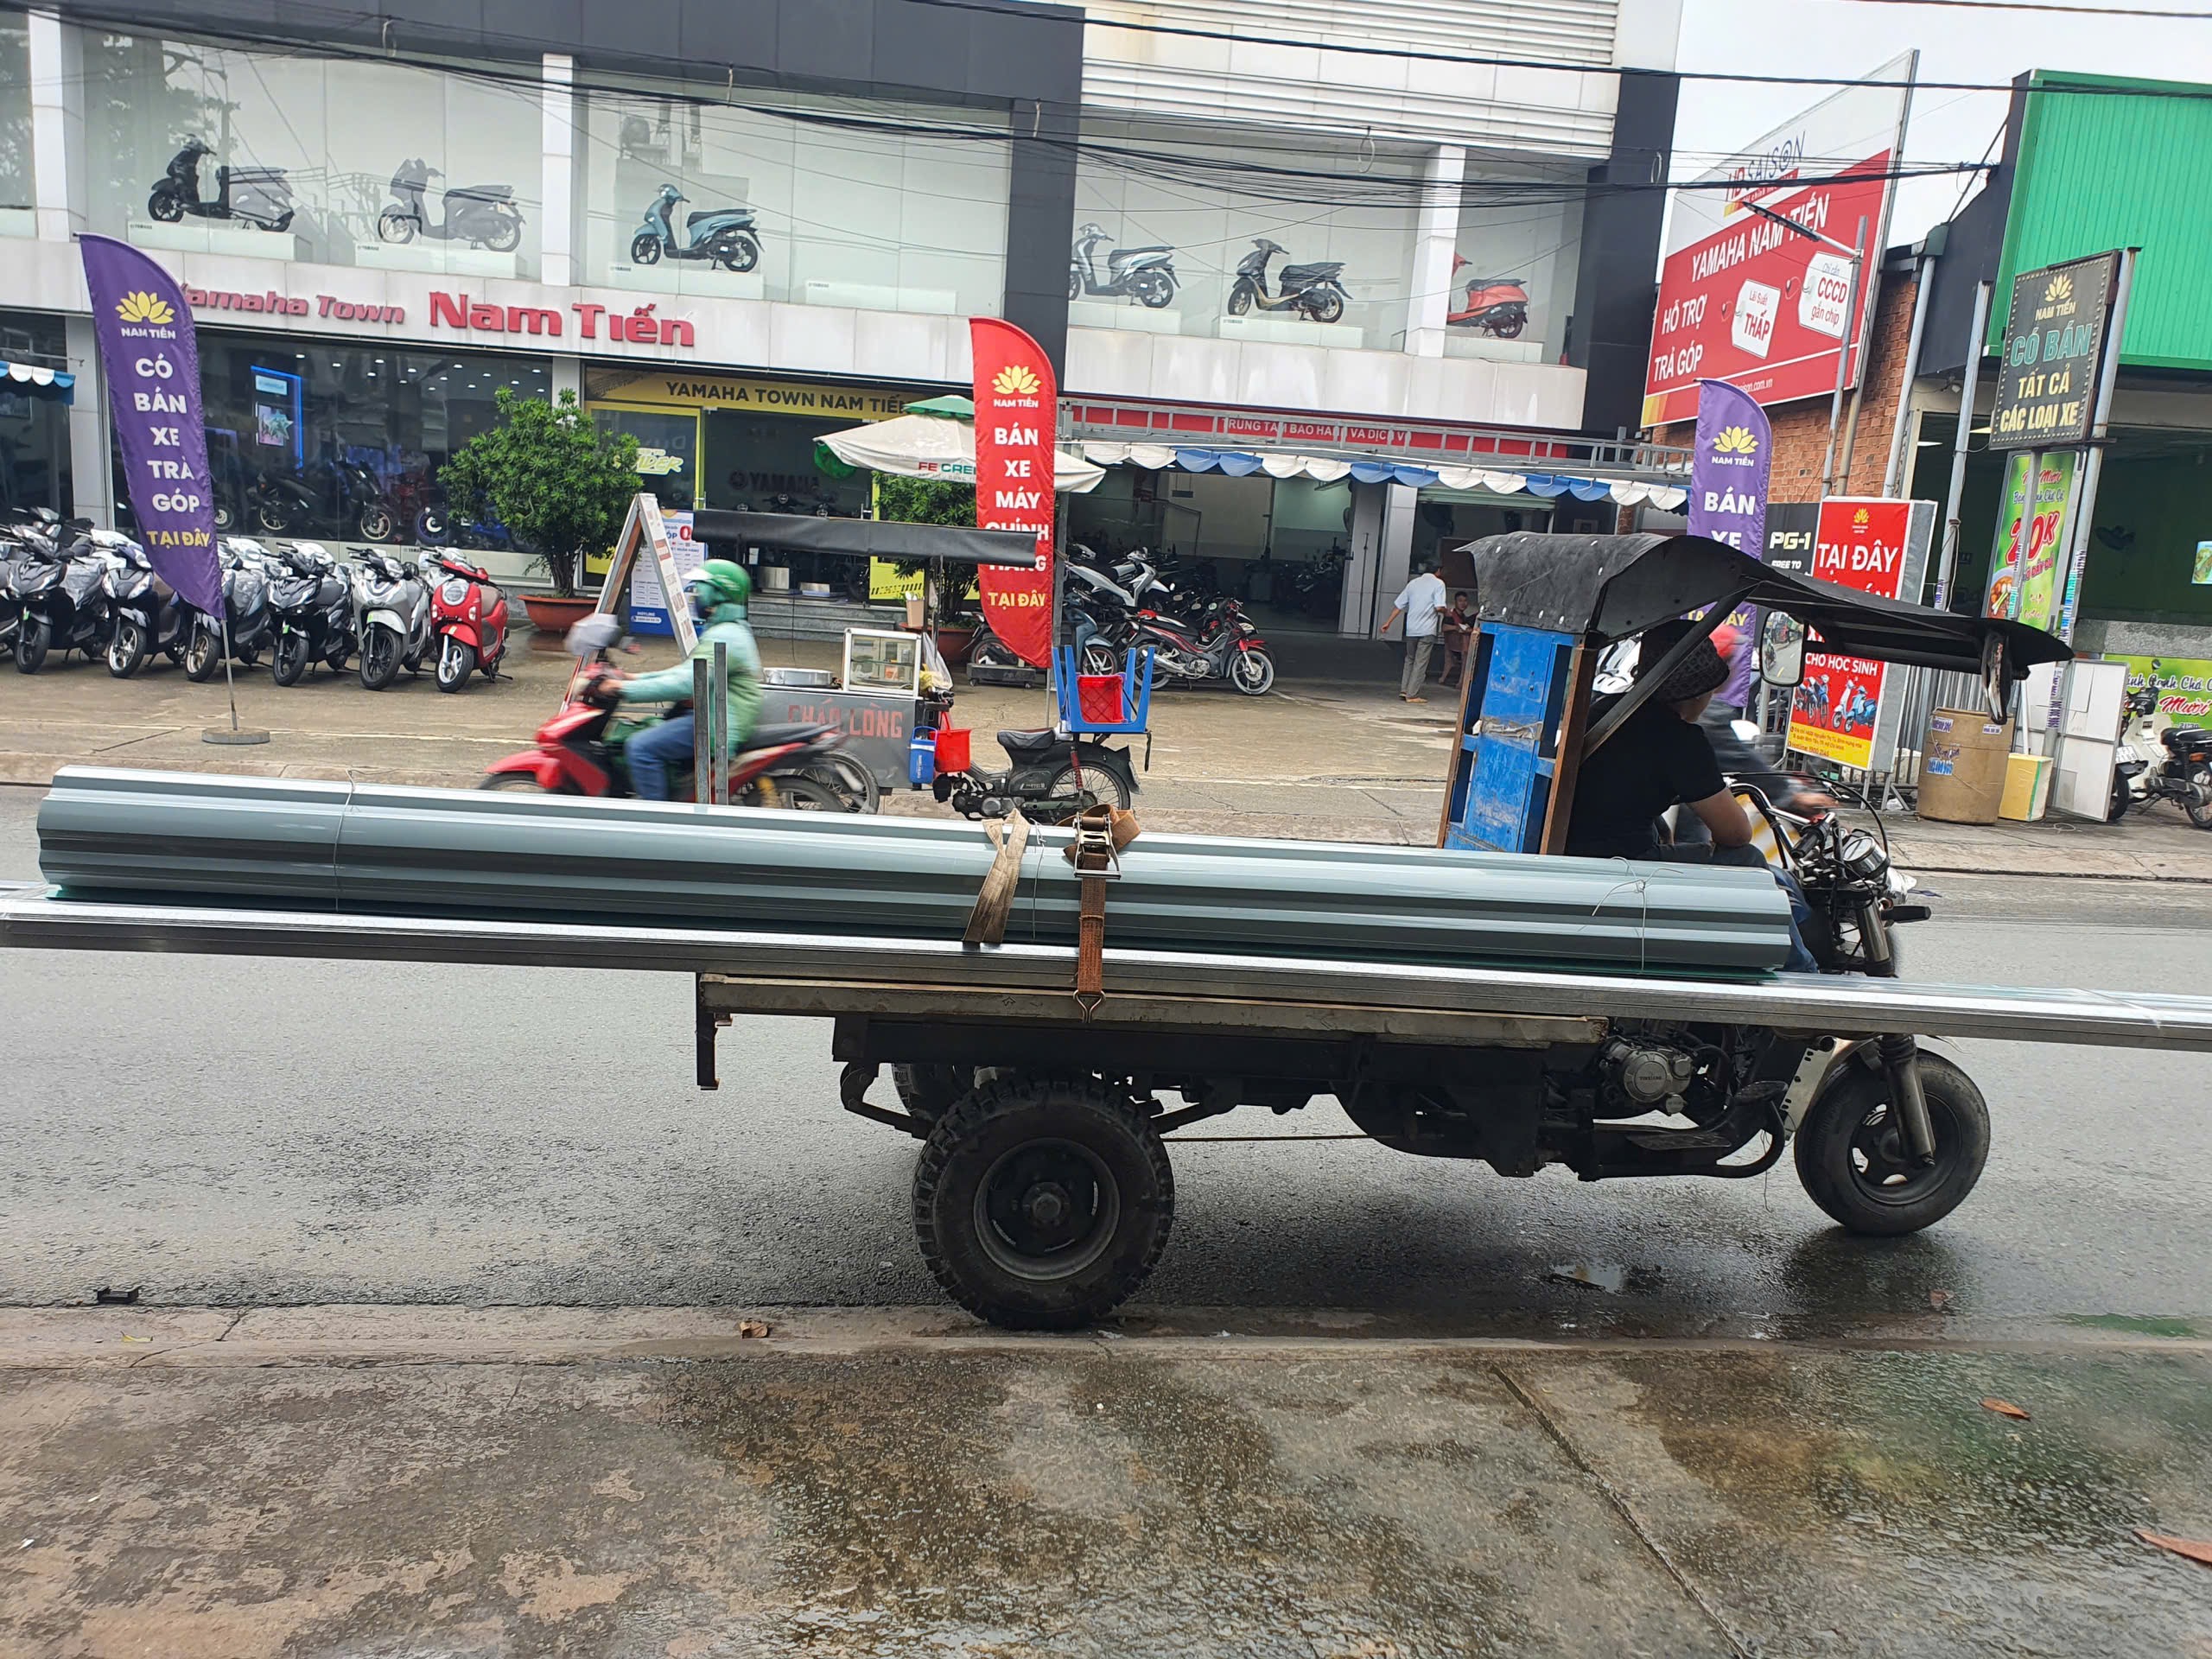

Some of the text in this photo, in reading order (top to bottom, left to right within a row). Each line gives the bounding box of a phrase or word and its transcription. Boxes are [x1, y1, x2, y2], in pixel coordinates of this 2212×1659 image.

[1692, 191, 1830, 283] YAMAHA NAM TIẾN
[1817, 276, 1848, 304] CCCD
[181, 283, 405, 324] amaha Town
[1662, 293, 1708, 335] HỖ TRỢ
[2035, 305, 2055, 321] NAM
[429, 291, 696, 347] Nam Tiến
[1744, 309, 1770, 341] THẤP
[1824, 307, 1840, 327] chip
[121, 327, 149, 339] NAM
[2010, 320, 2093, 367] CÓ BÁN
[135, 353, 174, 379] CÓ
[1654, 340, 1704, 382] TRẢ GÓP
[2018, 362, 2071, 400] TẤT CẢ
[133, 385, 188, 414] BÁN
[665, 381, 750, 402] YAMAHA
[754, 388, 816, 408] TOWN
[820, 394, 864, 411] NAM
[993, 398, 1016, 408] NAM
[1999, 400, 2081, 434] CÁC LOẠI XE
[149, 427, 181, 447] XE
[995, 422, 1039, 446] BÁN
[1368, 429, 1394, 442] DỊC
[918, 461, 976, 475] FE CRE
[1004, 459, 1031, 478] XE
[1711, 455, 1733, 466] NAM
[152, 487, 200, 513] GÓP
[995, 486, 1041, 509] MÁY
[1704, 486, 1756, 516] BÁN
[146, 527, 211, 550] TẠI ĐÂY
[1711, 530, 1743, 551] XE
[1769, 531, 1812, 550] PG-1
[1791, 560, 1802, 570] TO
[1818, 538, 1899, 575] TẠI ĐÂY
[988, 589, 1046, 610] TẠI ĐÂY
[1804, 652, 1878, 677] CHO HỌC SINH
[849, 702, 904, 739] LÒNG
